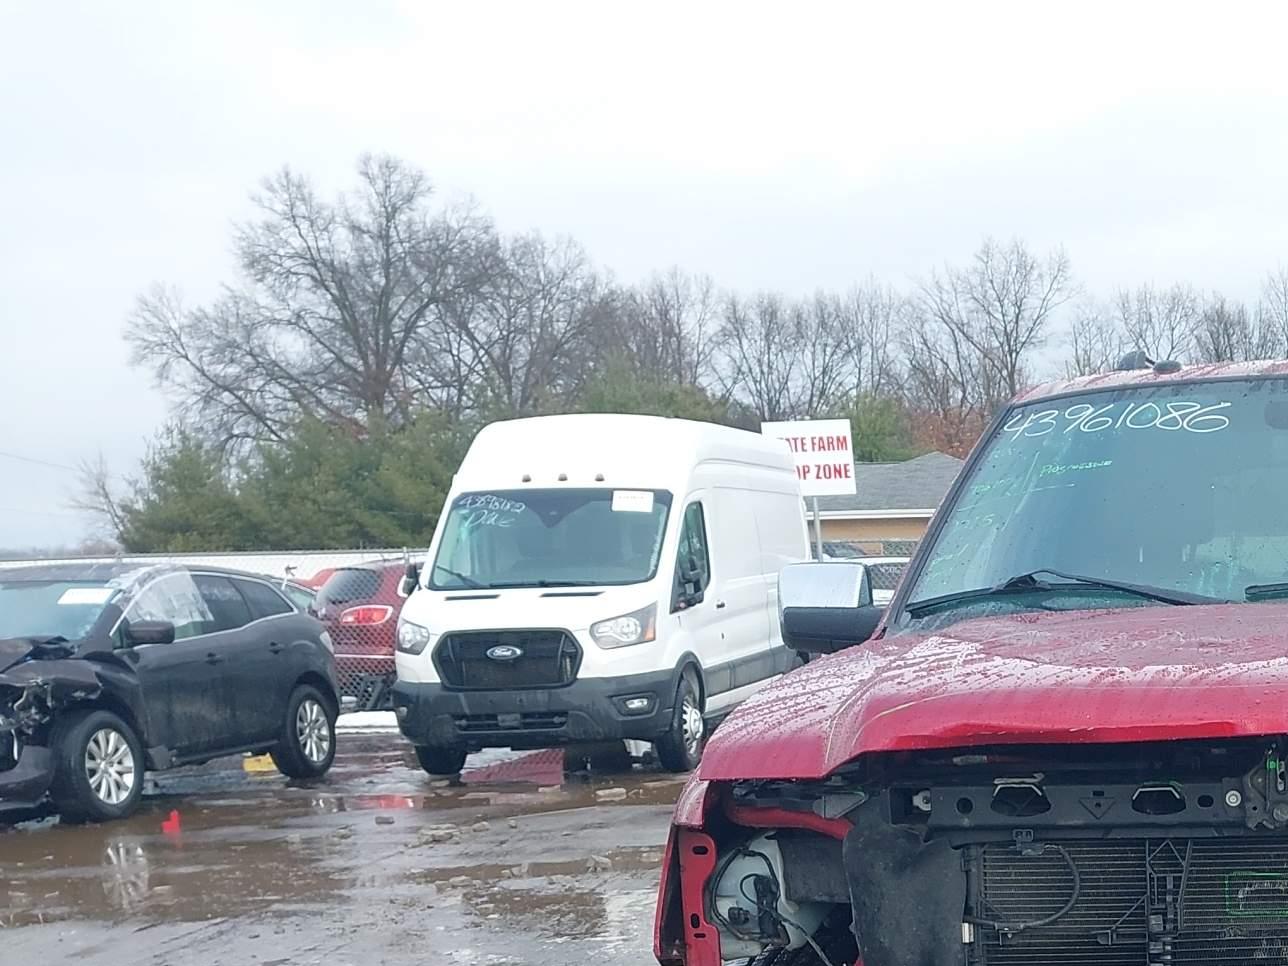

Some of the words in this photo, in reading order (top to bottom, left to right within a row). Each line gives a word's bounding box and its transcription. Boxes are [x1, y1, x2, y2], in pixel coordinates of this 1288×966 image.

[1003, 402, 1232, 441] 43961086
[811, 435, 848, 452] FARM
[815, 464, 851, 480] ZONE
